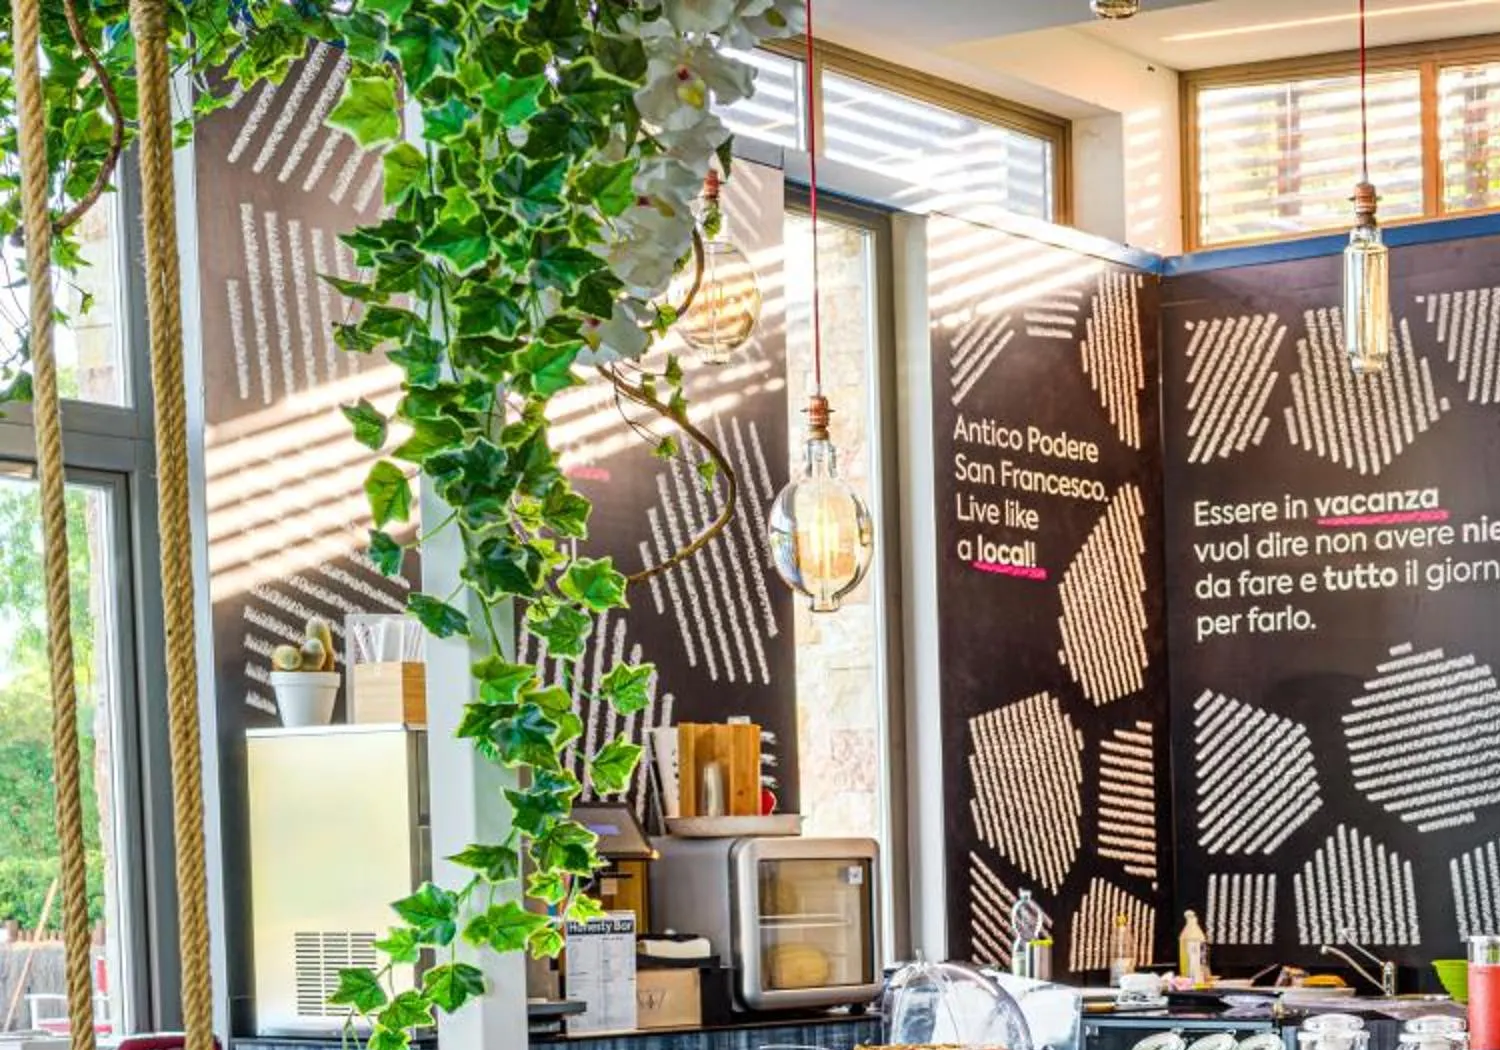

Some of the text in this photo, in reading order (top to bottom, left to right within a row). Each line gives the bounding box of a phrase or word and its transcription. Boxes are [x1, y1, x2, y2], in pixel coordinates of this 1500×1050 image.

[953, 414, 1099, 463] Antico Podere
[954, 453, 1109, 502] San Francesco.
[956, 493, 1039, 531] Live like
[1194, 487, 1440, 527] Essere in vacanza
[957, 534, 1037, 569] a local!
[1193, 533, 1250, 563] vuol
[1255, 531, 1309, 558] dire
[1315, 531, 1368, 555] non
[1374, 524, 1456, 551] avere
[1195, 572, 1232, 600] da
[1238, 569, 1294, 598] fare
[1299, 572, 1318, 593] e
[1322, 561, 1399, 592] tutto
[1404, 557, 1420, 587] il
[1196, 604, 1317, 643] per farlo.
